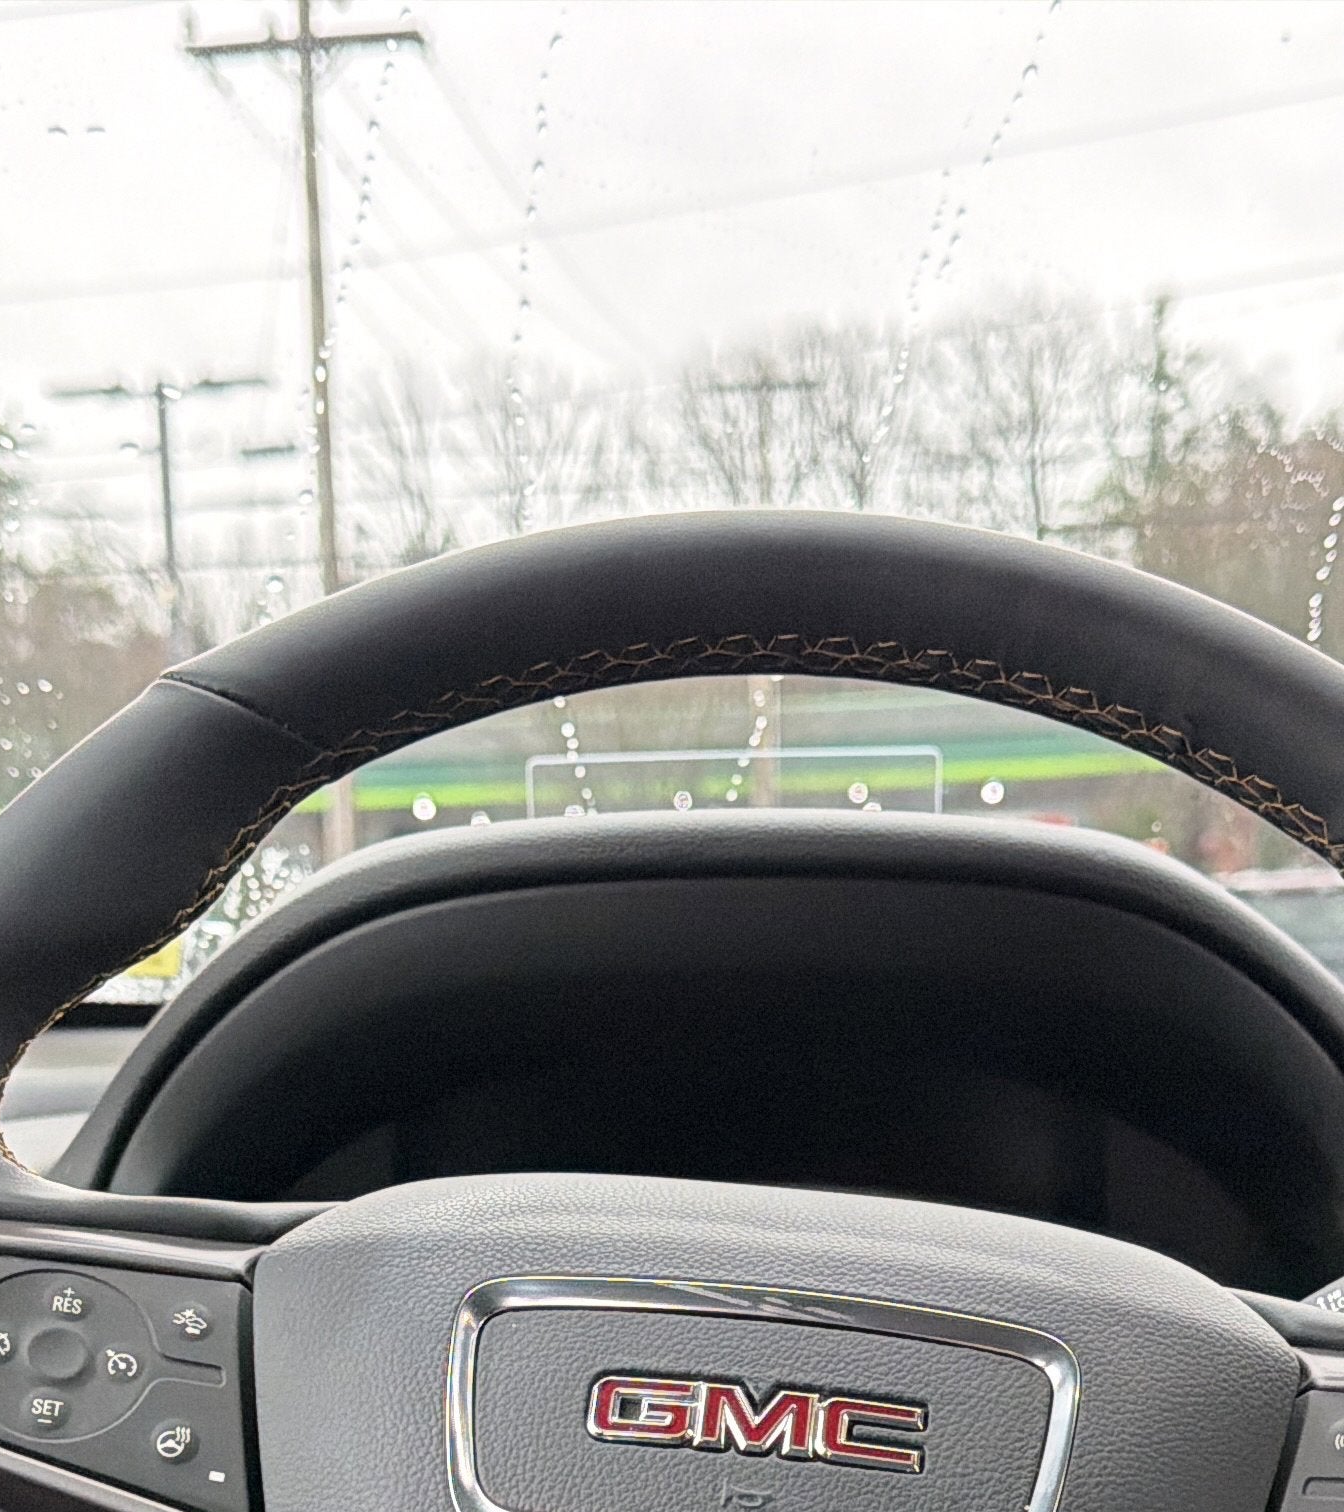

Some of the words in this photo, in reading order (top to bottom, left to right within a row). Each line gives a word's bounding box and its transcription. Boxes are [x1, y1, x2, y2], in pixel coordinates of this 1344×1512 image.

[51, 1296, 83, 1316] RES
[31, 1399, 65, 1418] SET
[587, 1374, 929, 1476] GMC
